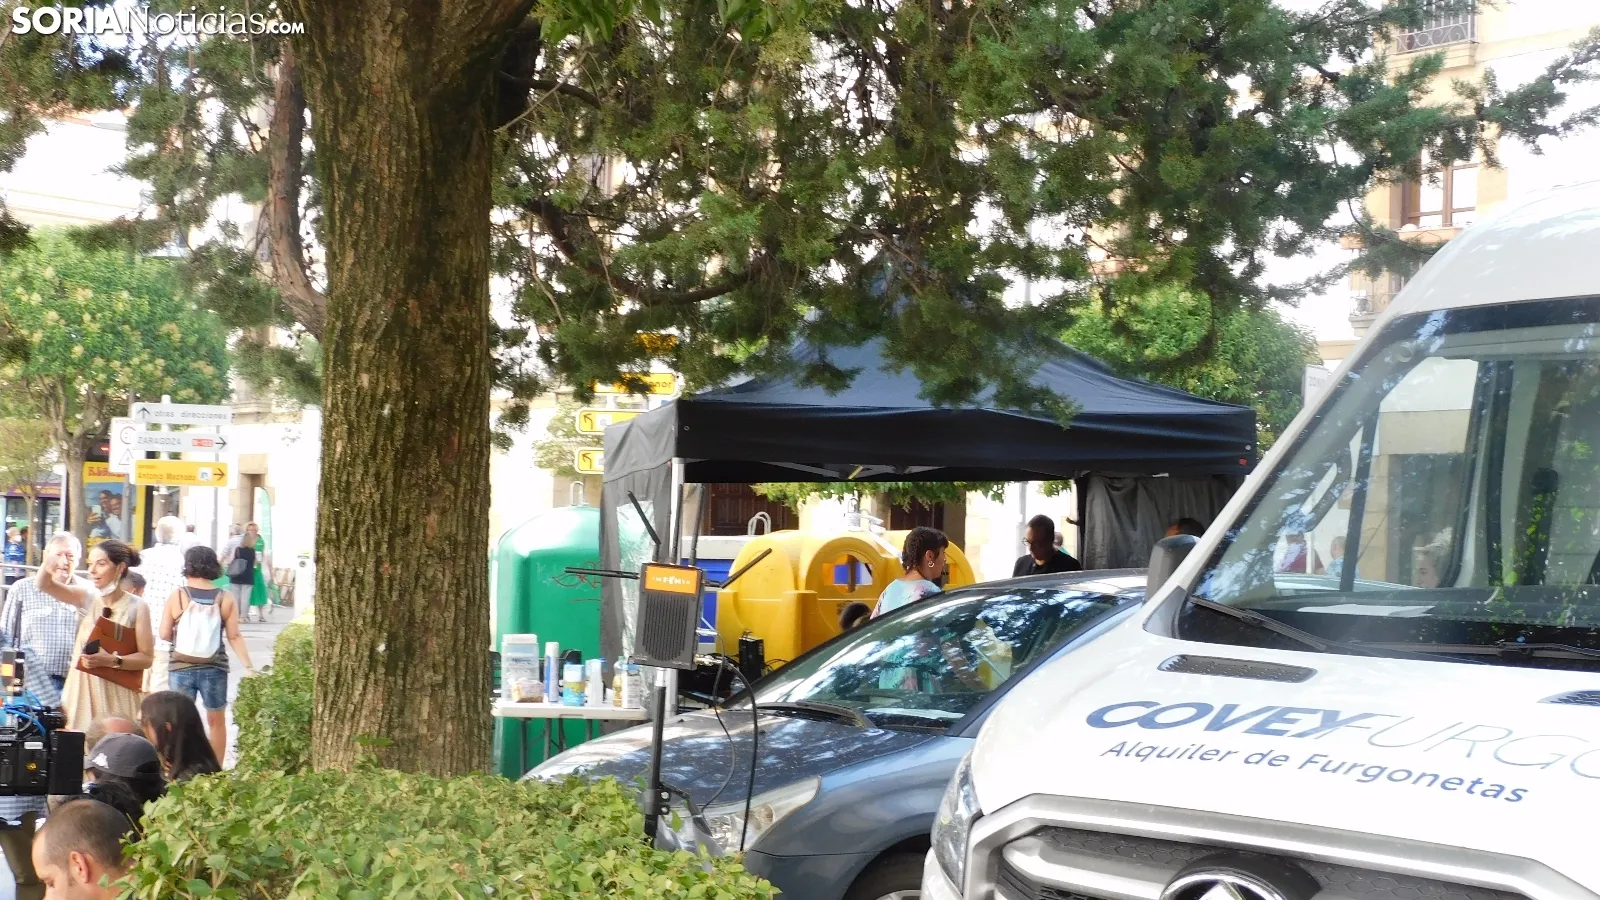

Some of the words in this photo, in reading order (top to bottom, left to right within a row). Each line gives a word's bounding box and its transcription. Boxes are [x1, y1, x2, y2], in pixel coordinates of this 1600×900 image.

[154, 410, 175, 418] otras
[180, 410, 228, 420] direcciones
[137, 436, 182, 445] ZARAGOZA
[138, 472, 164, 480] Antonio
[166, 472, 197, 481] Machado
[1100, 740, 1239, 762] Alquiler
[1243, 749, 1290, 767] de
[1297, 753, 1529, 803] Furgonetas
